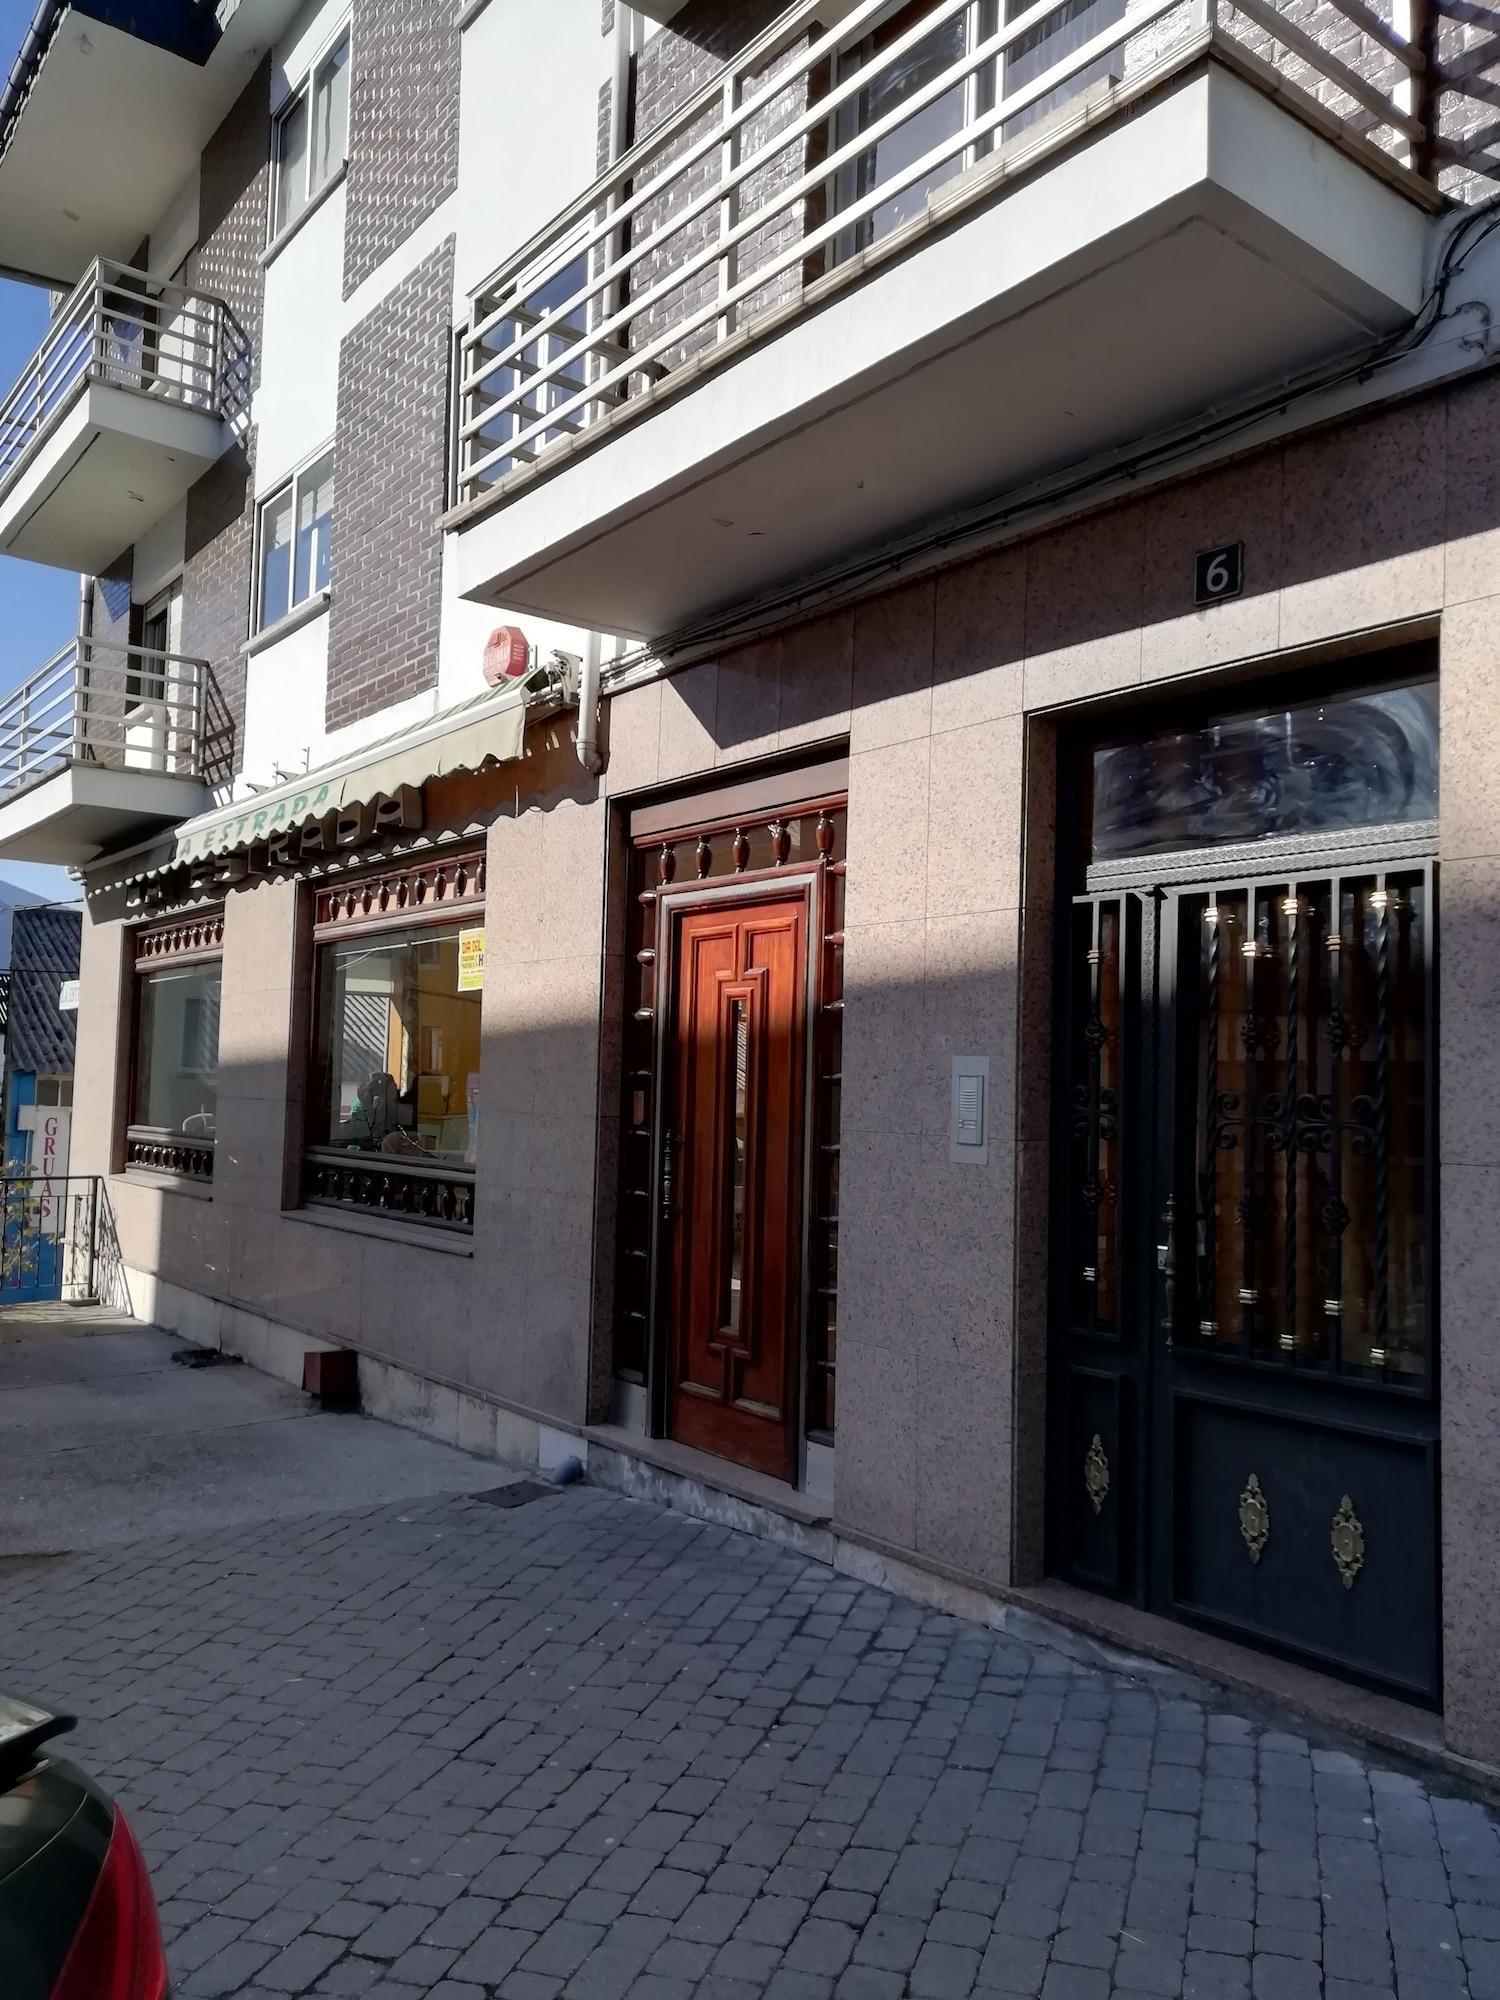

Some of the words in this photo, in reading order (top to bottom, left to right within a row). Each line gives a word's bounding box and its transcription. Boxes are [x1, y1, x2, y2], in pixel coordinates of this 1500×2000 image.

[1206, 553, 1229, 593] 6
[204, 784, 328, 850] ESTRADA
[41, 1117, 58, 1217] GRUAS
